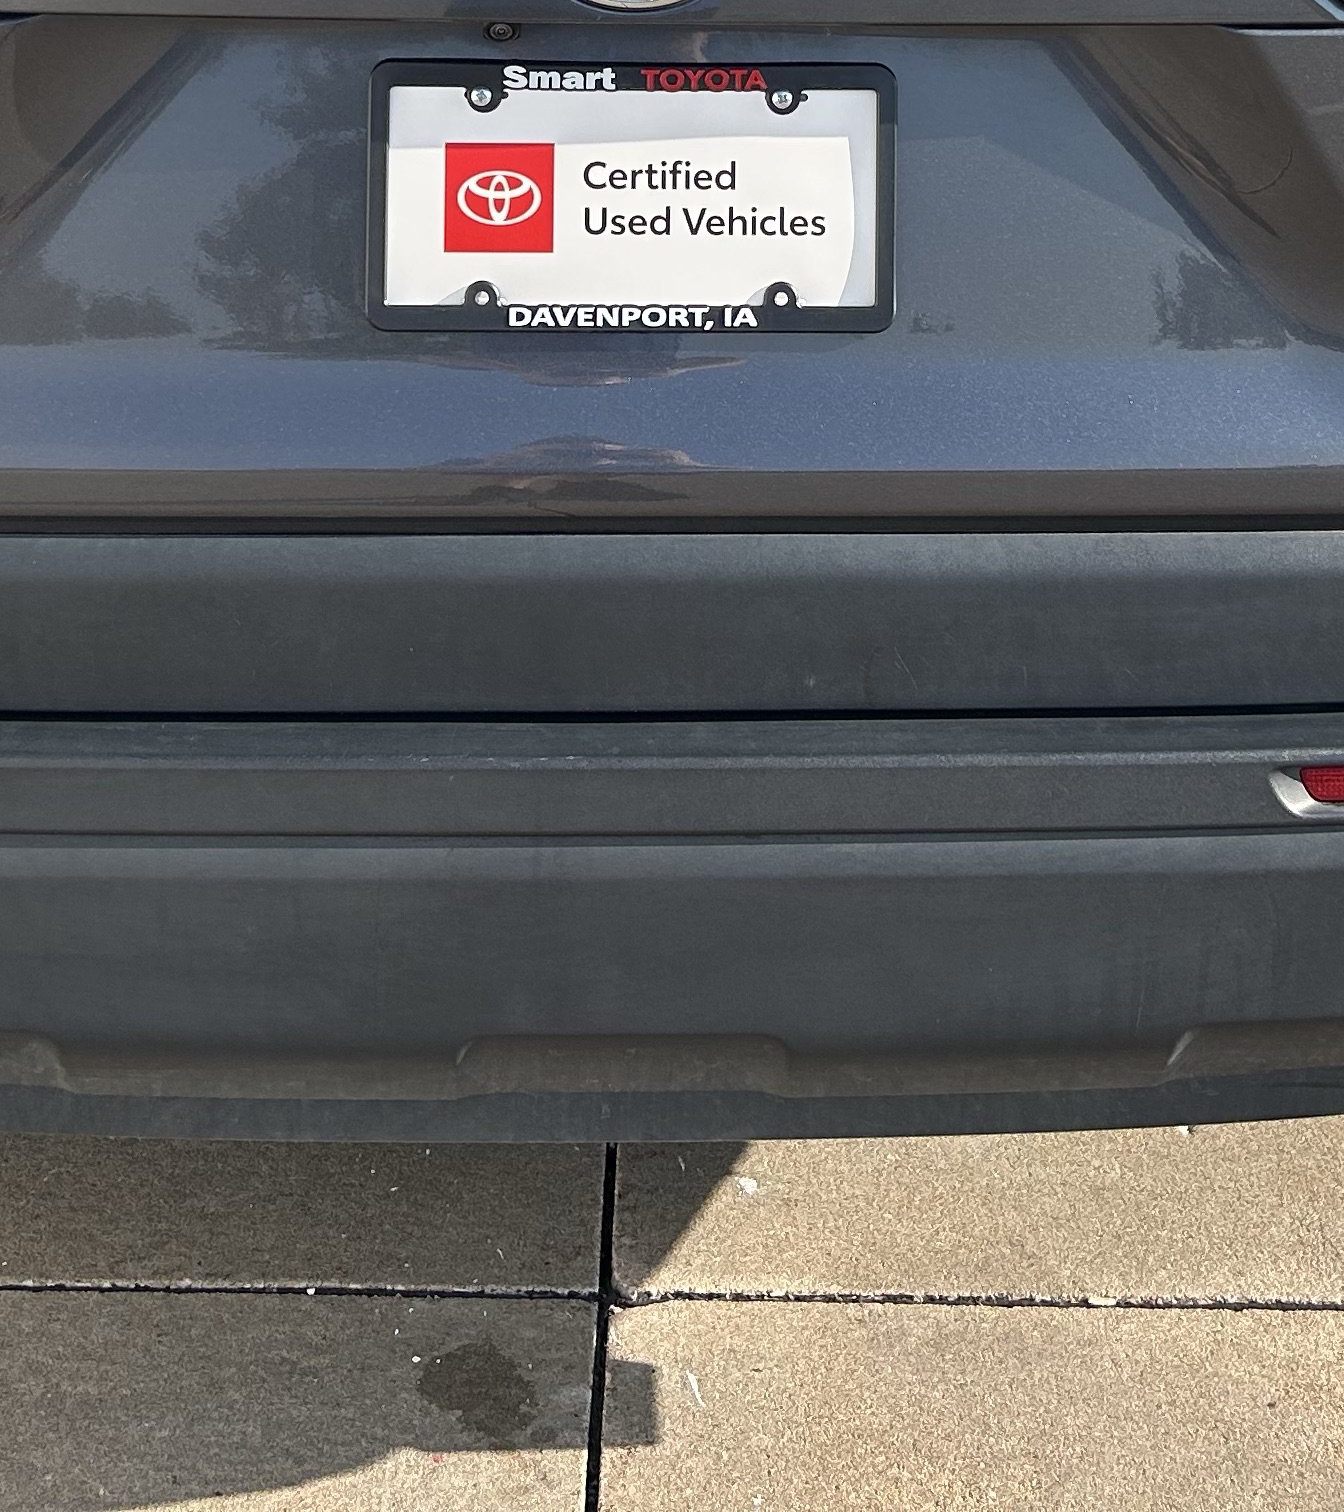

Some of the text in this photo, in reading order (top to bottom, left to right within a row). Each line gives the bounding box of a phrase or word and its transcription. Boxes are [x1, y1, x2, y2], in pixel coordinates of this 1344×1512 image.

[503, 65, 768, 92] Smart TOYOTA
[582, 160, 737, 191] Certified
[582, 207, 827, 238] Used Vehicles
[507, 305, 759, 332] DAVENPORT, IA
